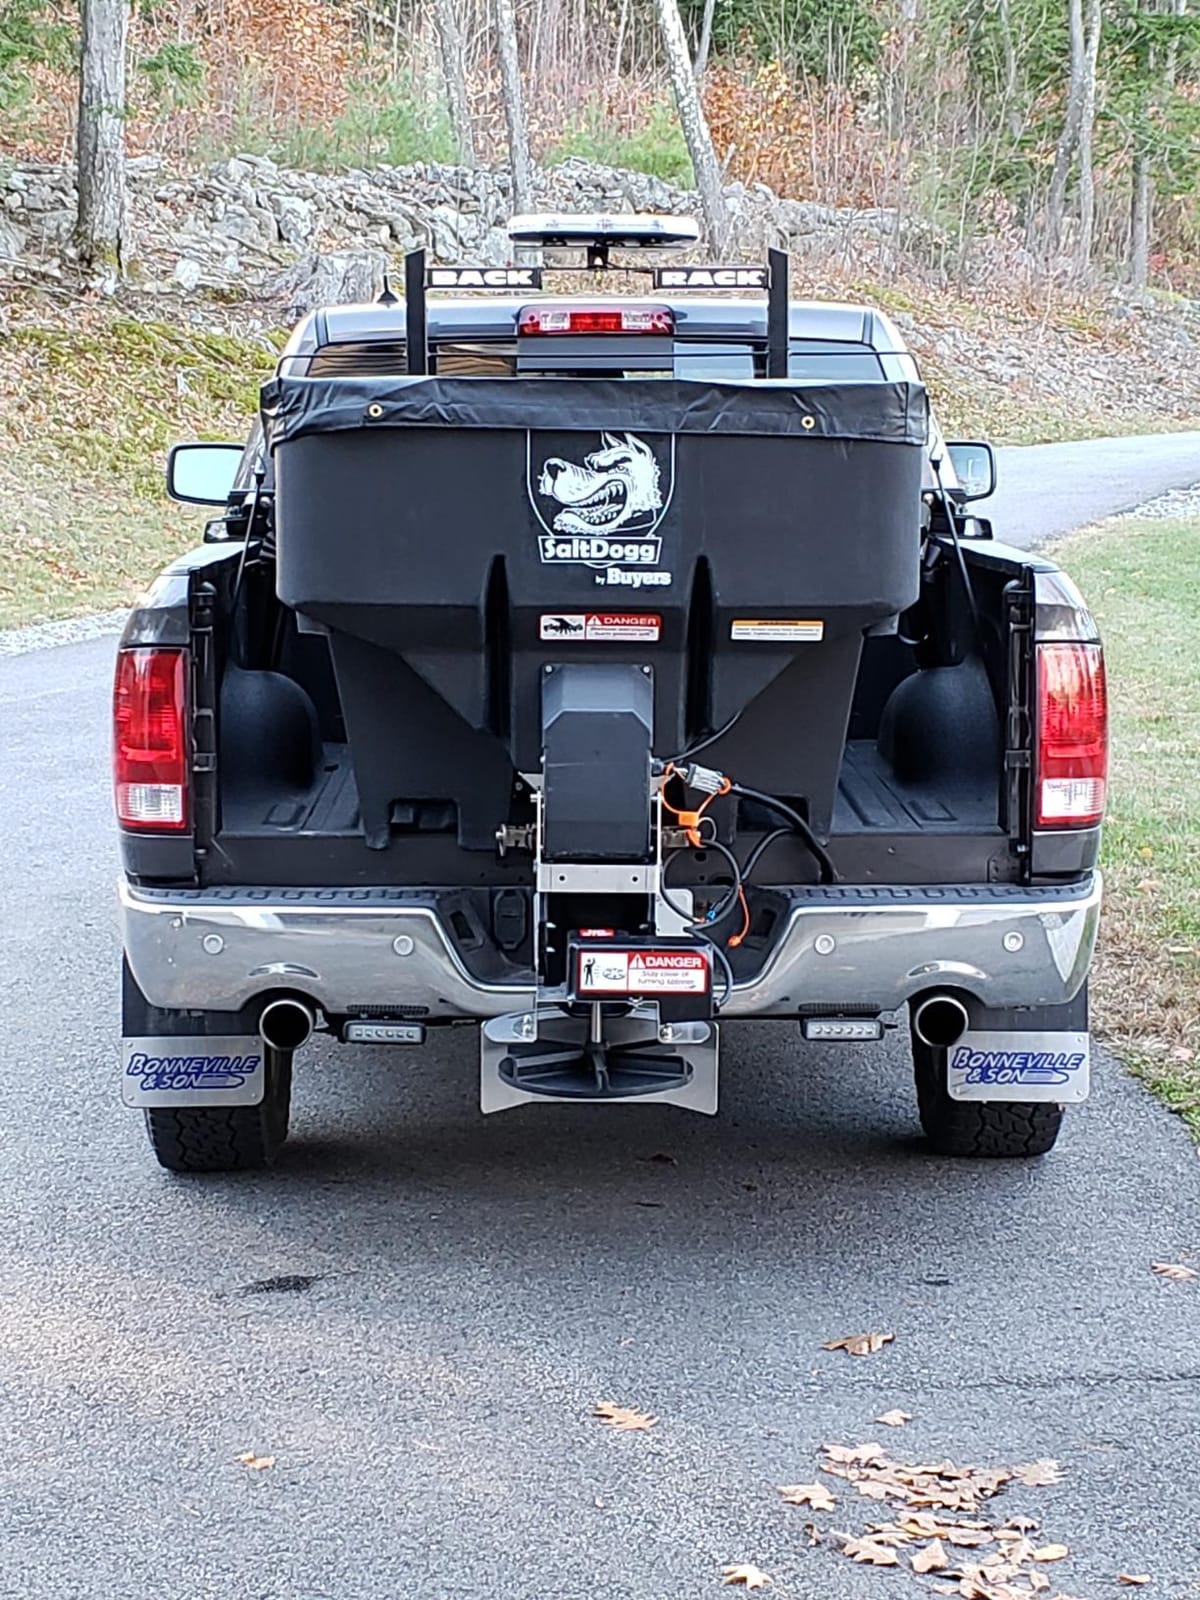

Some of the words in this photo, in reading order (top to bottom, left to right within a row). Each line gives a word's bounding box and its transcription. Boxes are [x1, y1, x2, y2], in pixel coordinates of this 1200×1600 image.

[432, 269, 533, 286] BACK
[660, 269, 763, 286] RACK
[544, 538, 655, 562] SaltDogg
[606, 567, 672, 588] Buyers
[603, 616, 656, 625] DANGER
[645, 956, 702, 968] DANGER
[127, 1053, 261, 1076] BONNEVILLE
[952, 1046, 1085, 1070] BONNEVILLE
[141, 1074, 158, 1090] &
[159, 1073, 202, 1089] SON
[967, 1068, 981, 1084] &
[983, 1067, 1026, 1084] SON
